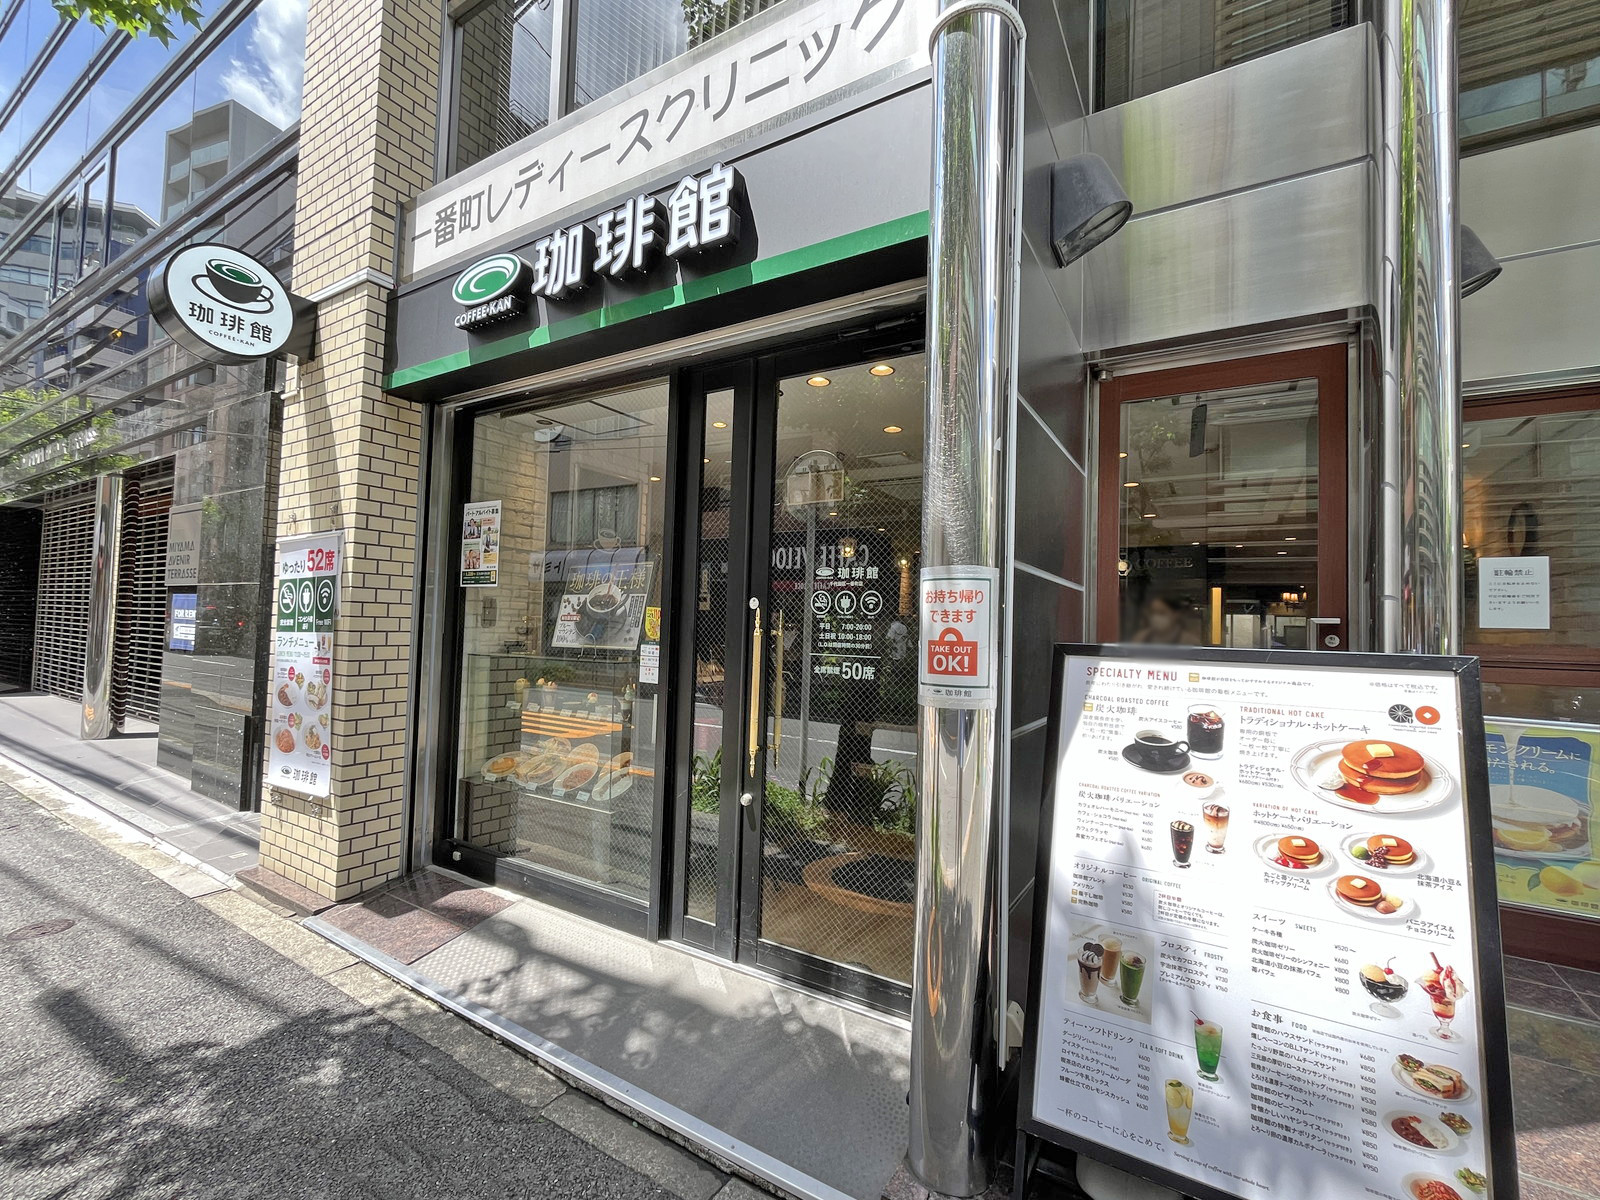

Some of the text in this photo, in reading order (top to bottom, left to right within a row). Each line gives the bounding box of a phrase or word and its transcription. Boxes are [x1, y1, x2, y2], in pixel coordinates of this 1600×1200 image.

[411, 0, 903, 247] 一番町レディースクリニック
[531, 162, 736, 295] 珈琲館
[189, 302, 273, 344] 珈琲館
[169, 540, 195, 553] MIYAMA
[168, 555, 190, 566] AVENIR
[283, 548, 335, 574] ゆったり 52席
[167, 568, 197, 579] TERRASSE
[569, 567, 646, 591] 珈琲の王様
[837, 566, 879, 579] 珈琲館
[925, 589, 984, 604] お持ち帰り
[174, 609, 184, 618] FOR
[930, 608, 976, 623] できます
[277, 635, 314, 648] ランチメニュー
[930, 644, 972, 654] TAKE OUT
[932, 655, 969, 672] OK!
[841, 662, 875, 680] 50席
[1087, 666, 1178, 682] SPECIALTY MENU
[945, 688, 972, 698] 珈琲館
[1085, 694, 1169, 707] CHARCOAL ROASTED COFFEE
[1096, 704, 1137, 715] 炭火珈琲
[1240, 706, 1325, 719] TRADITIONAL HOT CAKE
[1240, 715, 1371, 735] トラディショナル・ホットケーキ
[1078, 782, 1161, 799] CHARCOAL ROASTED COFFEE VARIATION
[1078, 790, 1161, 808] 炭火珈琲バリエーション
[1253, 802, 1280, 811] VARIATION
[1253, 810, 1353, 830] ホットケーキバリエーション
[1073, 861, 1137, 879] オリジナルコーヒー
[1072, 881, 1095, 890] アメリカン
[1142, 876, 1182, 890] ORIGINAL COFFEE
[1263, 878, 1310, 891] ホイップクリーム
[1417, 880, 1454, 891] 抹茶アイス
[1253, 913, 1286, 925] スイーツ
[1251, 926, 1283, 938] ケーキ各種
[1295, 923, 1317, 933] SWEETS
[1406, 925, 1455, 940] チョコクリーム
[1161, 940, 1198, 955] フロスティ
[1251, 938, 1295, 952] 炭火珈琲ゼリー
[1204, 951, 1224, 962] FROSTY
[1251, 947, 1349, 975] 炭火珈琲ゼリーのシンフォニー ¥800
[1160, 970, 1211, 988] プレミアムフロスティ
[1334, 976, 1349, 985] ¥800
[1335, 986, 1350, 995] ¥800
[1251, 1008, 1284, 1024] お食事
[1063, 1017, 1134, 1044] ティー・ソフトドリンク
[1291, 1021, 1308, 1031] FOOD
[1139, 1041, 1184, 1060] TEA SOFT DRINK
[1251, 1042, 1376, 1084] たっぷり野菜のハムチーズサンド ¥650
[1360, 1053, 1376, 1063] ¥680
[1360, 1064, 1376, 1074] ¥850
[1060, 1066, 1110, 1087] フルーツ牛乳ミックス
[1360, 1085, 1377, 1095] ¥850
[1251, 1083, 1377, 1128] 珈琲館のピザトースト ¥580
[1360, 1096, 1377, 1106] ¥530
[1361, 1106, 1377, 1116] ¥580
[1057, 1107, 1165, 1152] 一杯のコーヒーに心をこめて。
[1361, 1129, 1378, 1139] ¥850
[1362, 1140, 1378, 1150] ¥850
[1362, 1151, 1378, 1161] ¥850
[1362, 1163, 1379, 1173] ¥950
